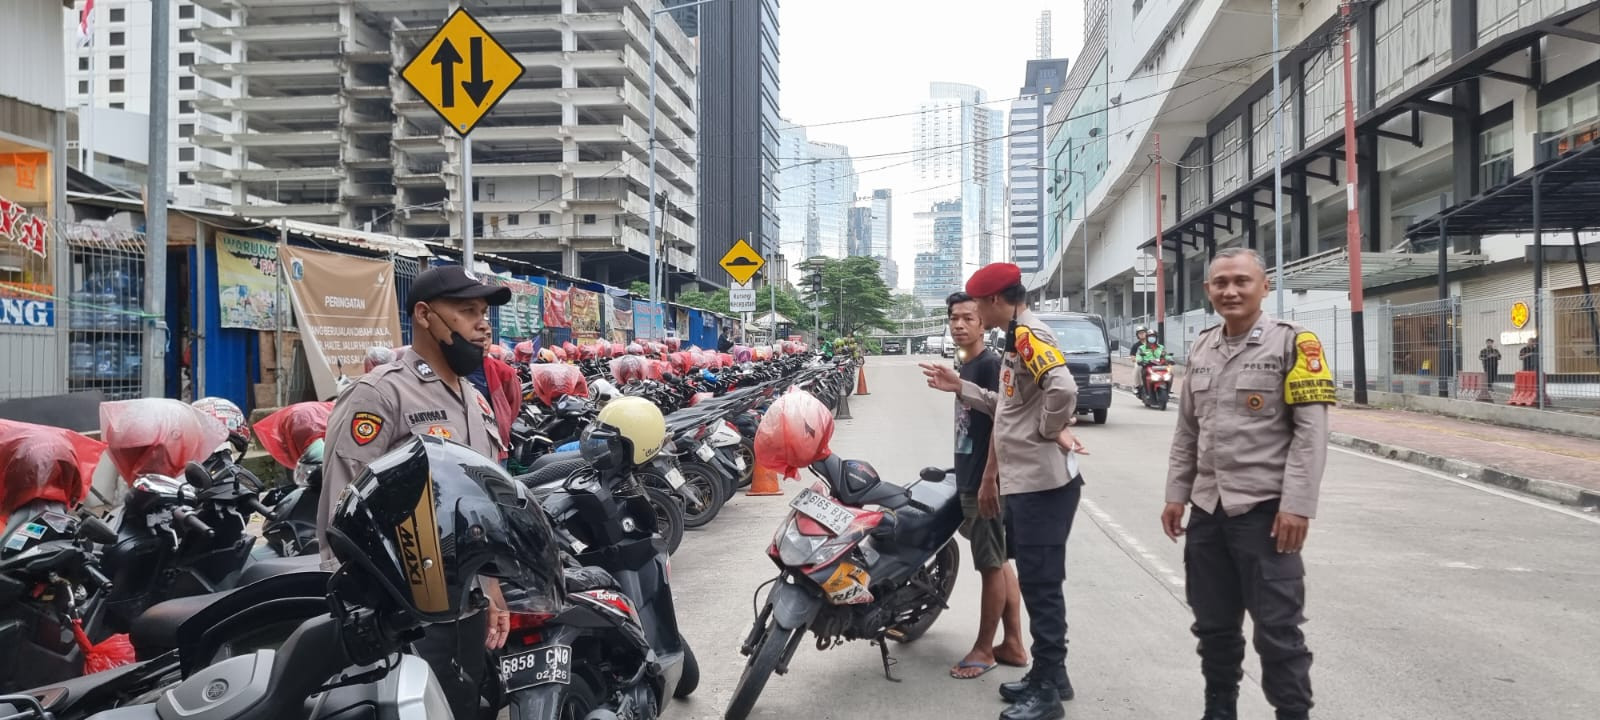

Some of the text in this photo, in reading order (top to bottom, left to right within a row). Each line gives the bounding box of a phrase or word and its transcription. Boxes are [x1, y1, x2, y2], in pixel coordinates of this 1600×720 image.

[223, 236, 277, 258] WARUNG
[324, 295, 366, 310] PERINGATAN
[400, 526, 423, 585] MAXI
[502, 654, 535, 675] 6858
